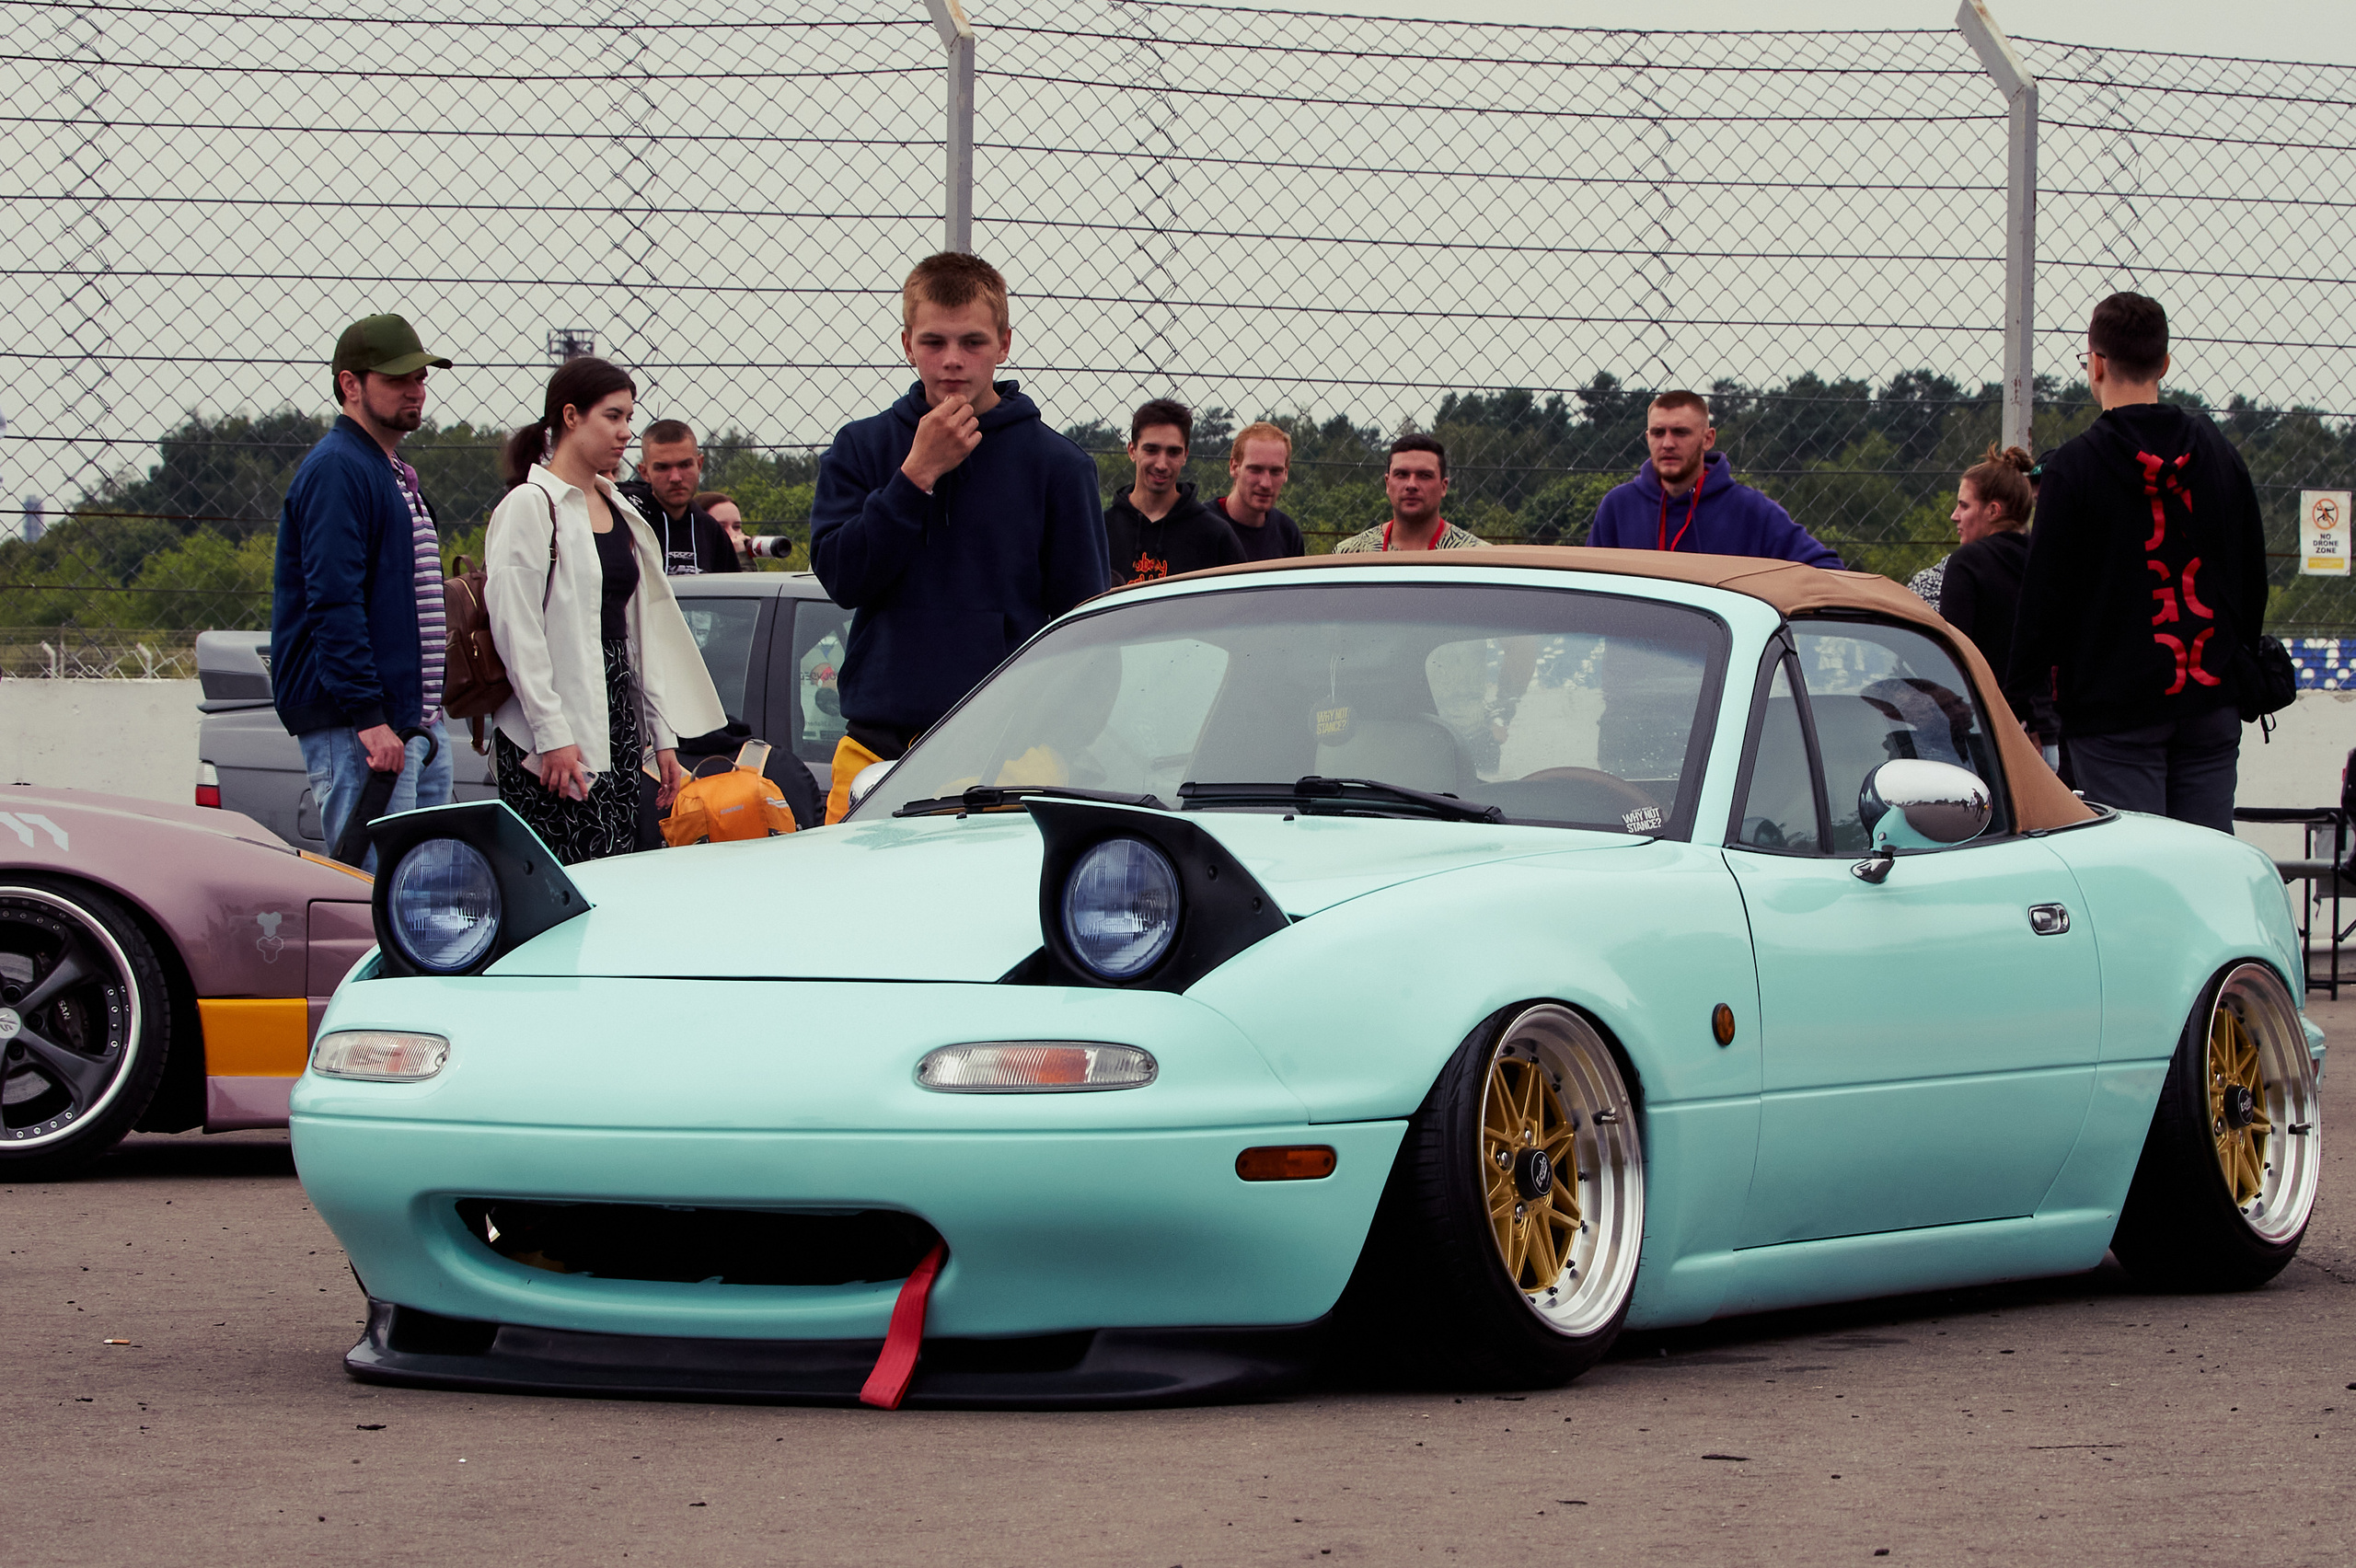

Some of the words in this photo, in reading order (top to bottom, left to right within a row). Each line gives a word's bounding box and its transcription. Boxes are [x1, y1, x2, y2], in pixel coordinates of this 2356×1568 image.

[1316, 709, 1334, 722] WHY
[1335, 707, 1348, 720] NOT
[1317, 720, 1346, 735] STANCE?
[1622, 811, 1643, 824] WHY
[1644, 808, 1659, 820] NOT
[1626, 817, 1661, 833] STANCE?
